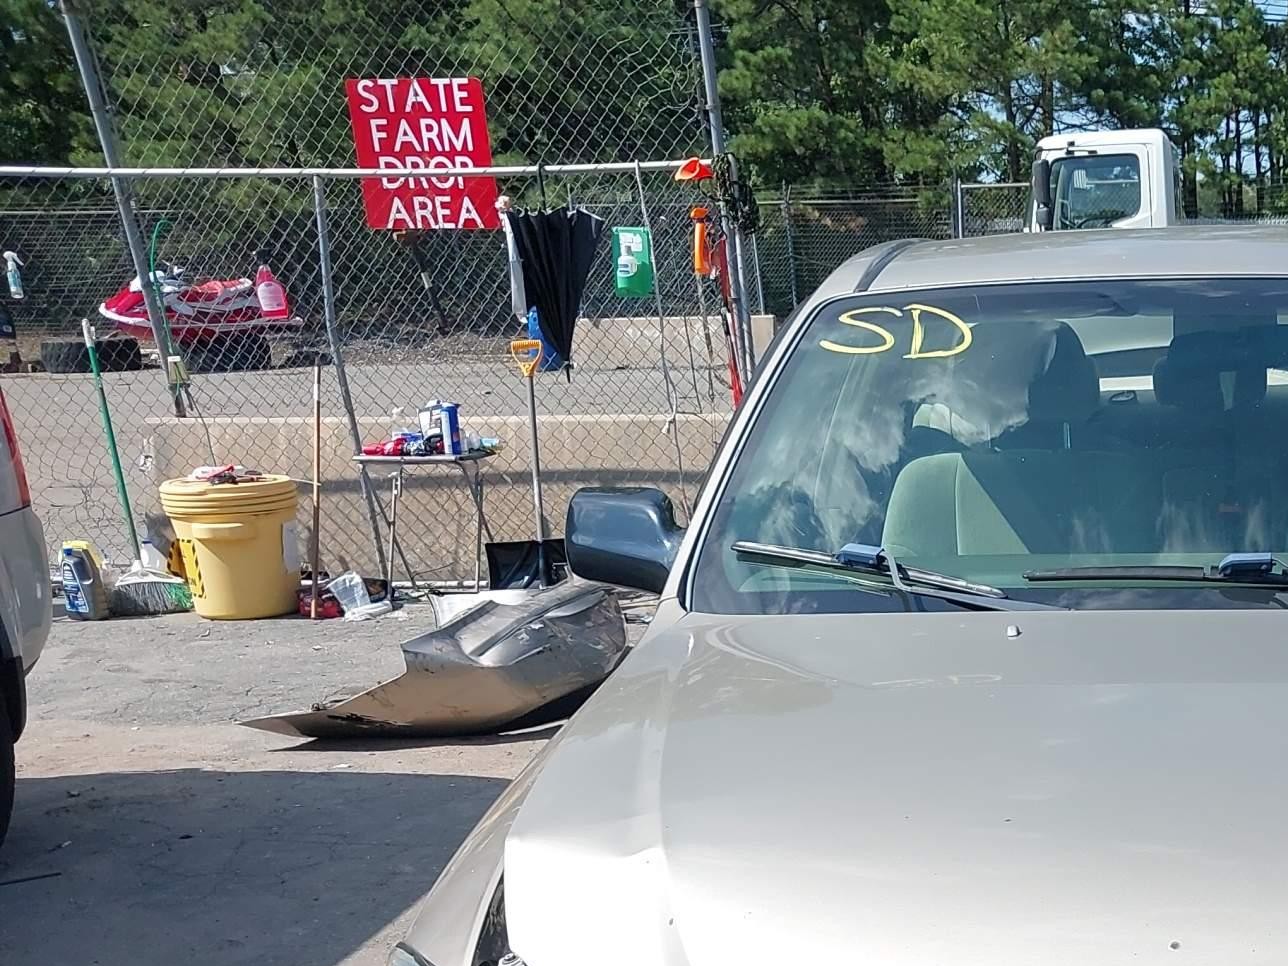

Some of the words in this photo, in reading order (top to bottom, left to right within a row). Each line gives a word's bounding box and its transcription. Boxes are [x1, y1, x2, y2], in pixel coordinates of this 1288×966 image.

[357, 78, 473, 113] STATE
[369, 117, 474, 152] FARM
[378, 156, 474, 189] DROP
[386, 196, 485, 229] AREA
[819, 304, 974, 358] SD
